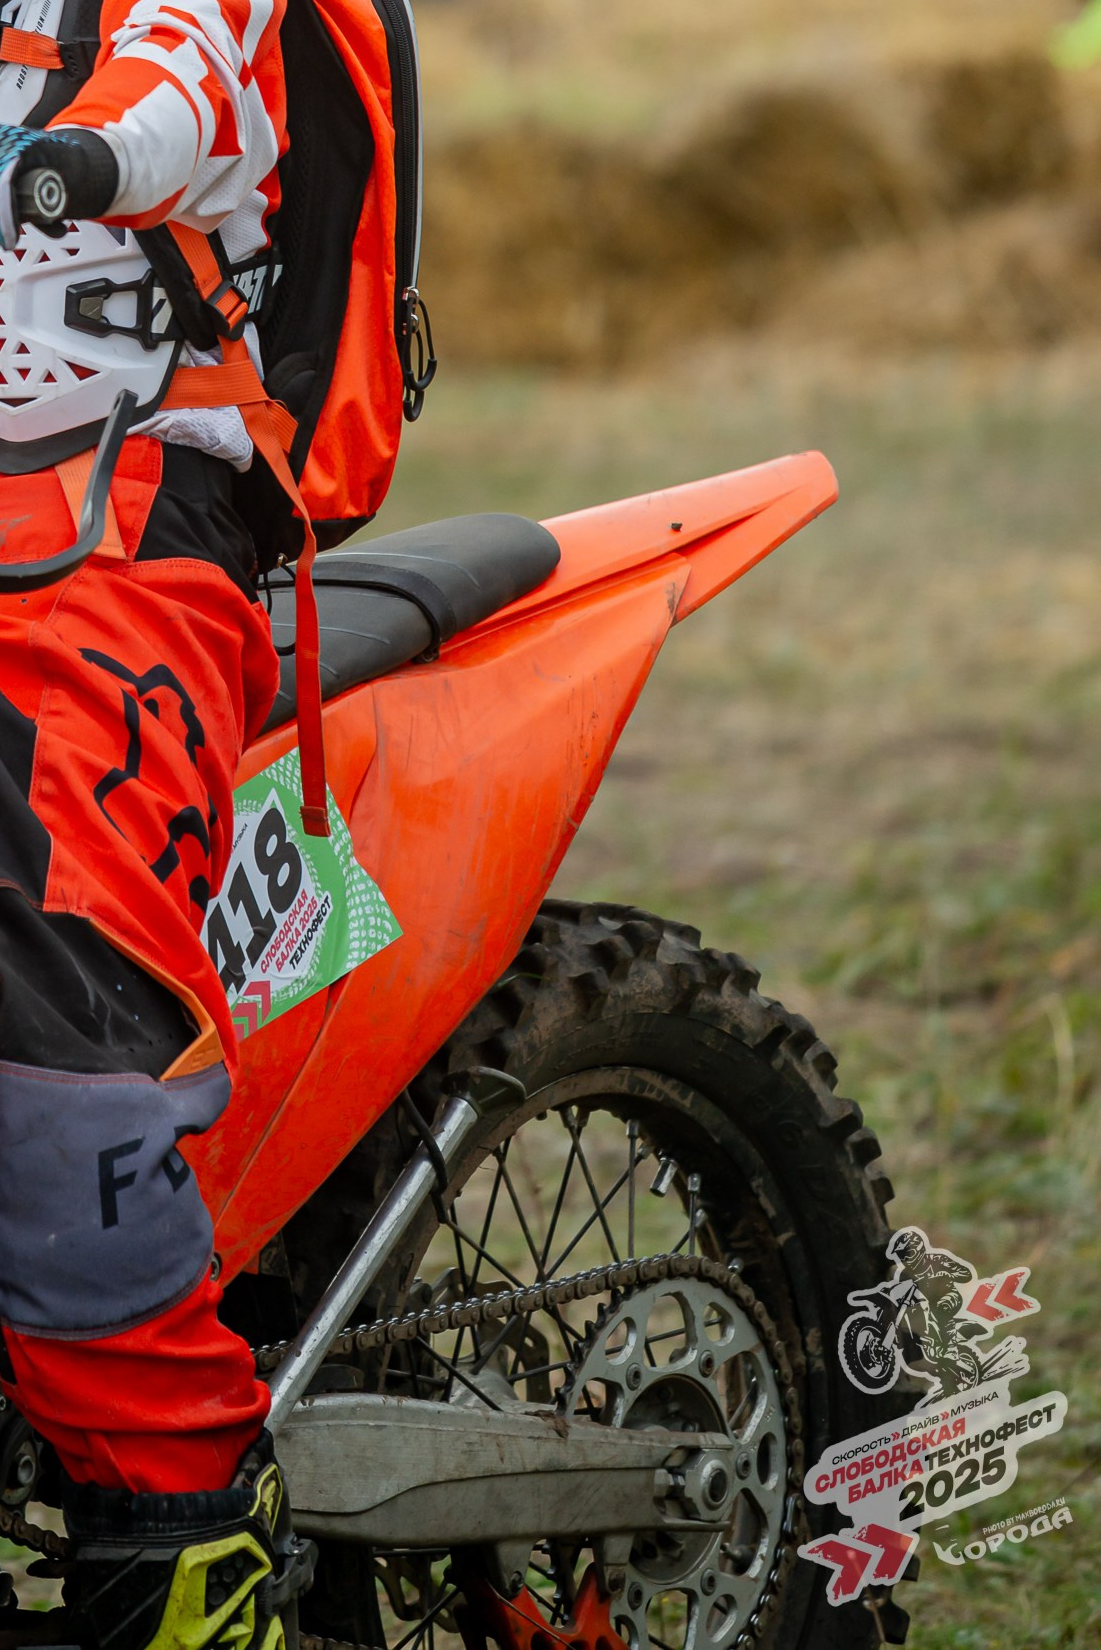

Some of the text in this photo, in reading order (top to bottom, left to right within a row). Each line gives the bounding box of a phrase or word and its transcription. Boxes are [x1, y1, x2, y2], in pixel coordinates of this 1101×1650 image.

[207, 807, 302, 995] 418
[261, 888, 308, 974] СЛОБОДСКАЯ
[275, 896, 318, 973] БАЛКА 2025
[289, 894, 331, 970] ТЕХНОФЕСТ
